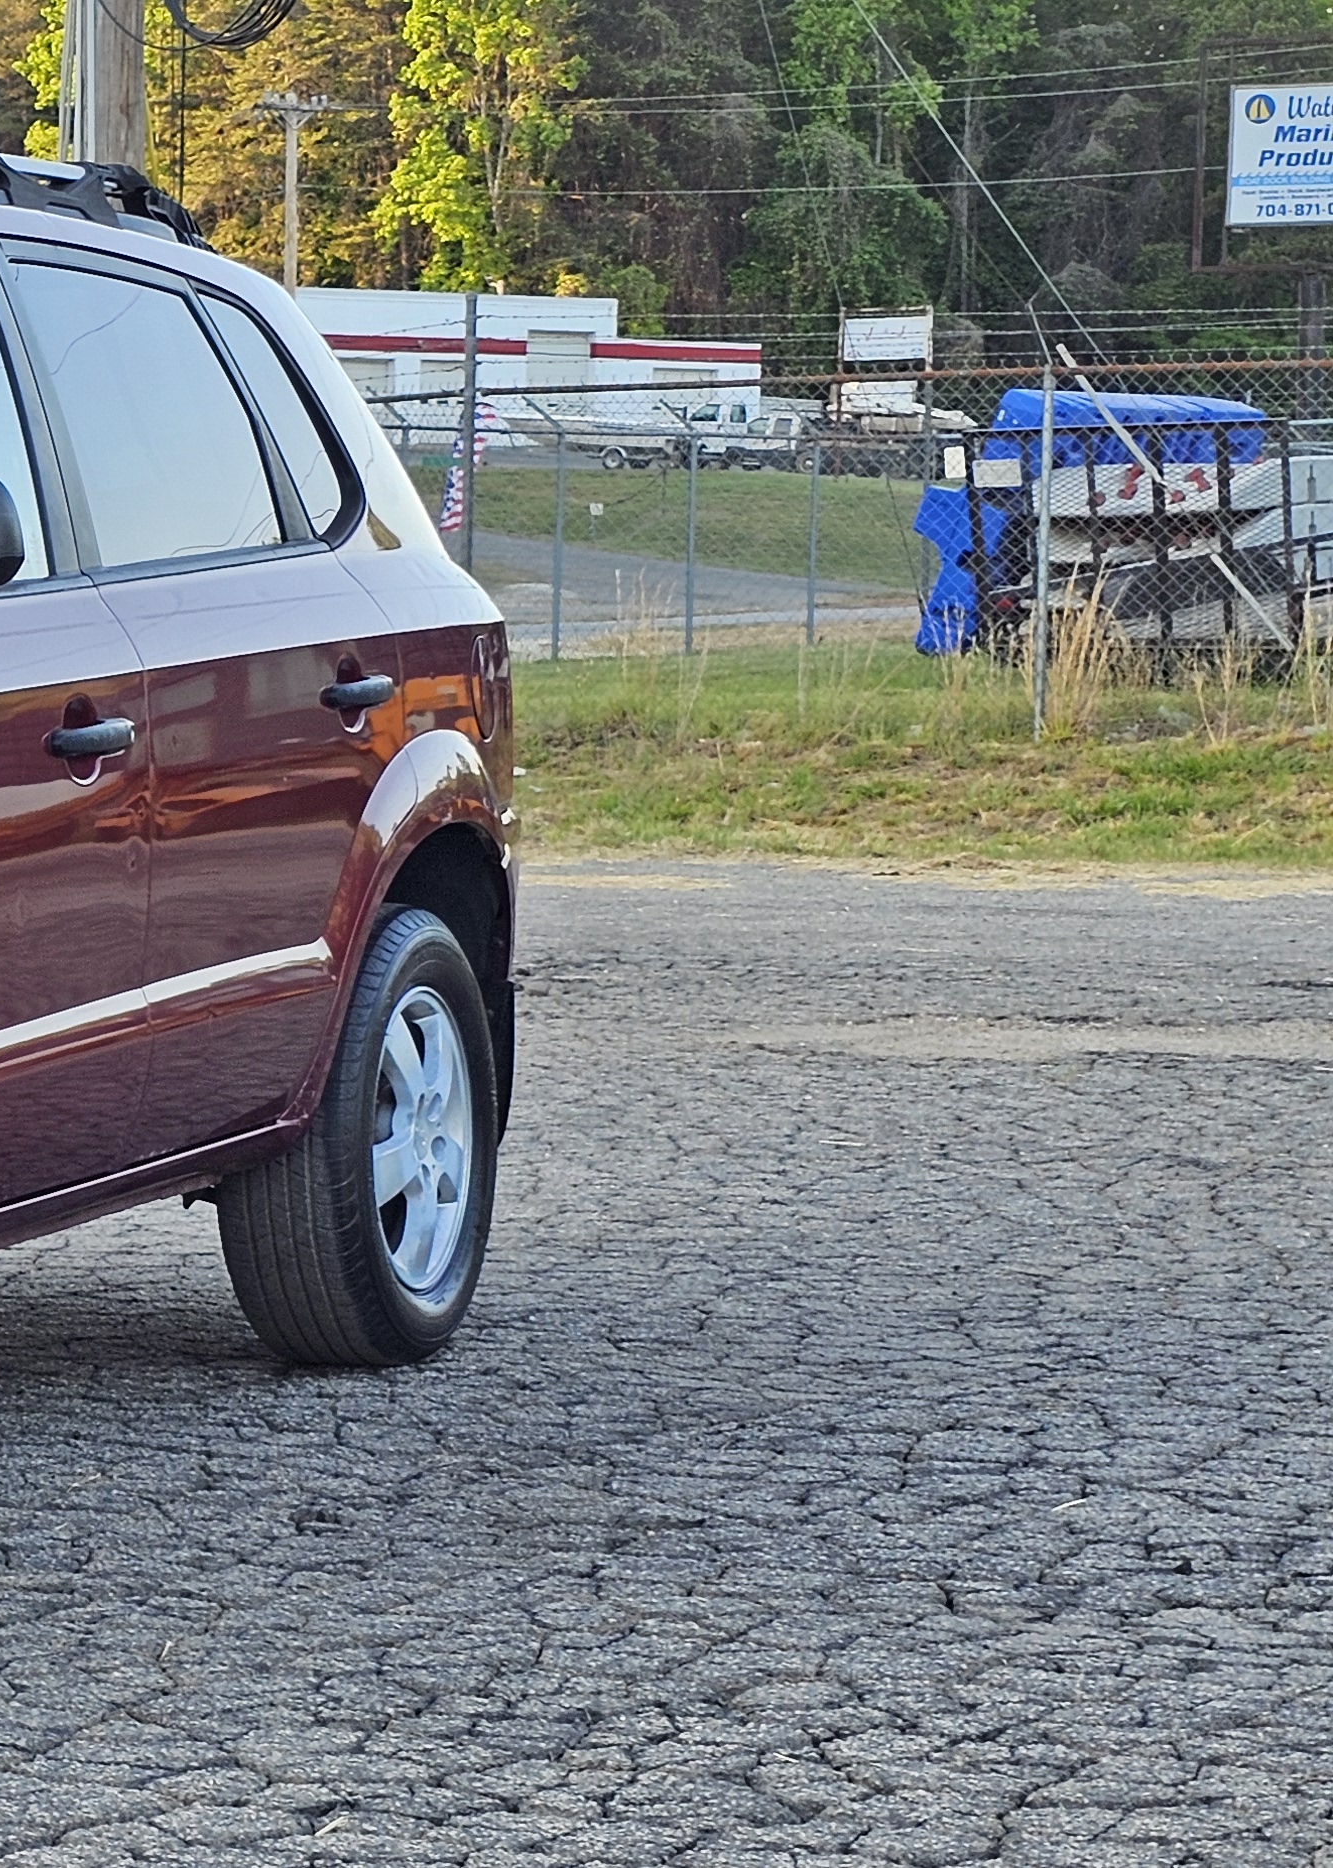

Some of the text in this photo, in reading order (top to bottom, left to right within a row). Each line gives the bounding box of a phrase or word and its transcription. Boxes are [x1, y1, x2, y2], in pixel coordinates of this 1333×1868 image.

[1288, 96, 1333, 119] Wat
[1274, 124, 1333, 143] Mari
[1258, 148, 1333, 167] Produ
